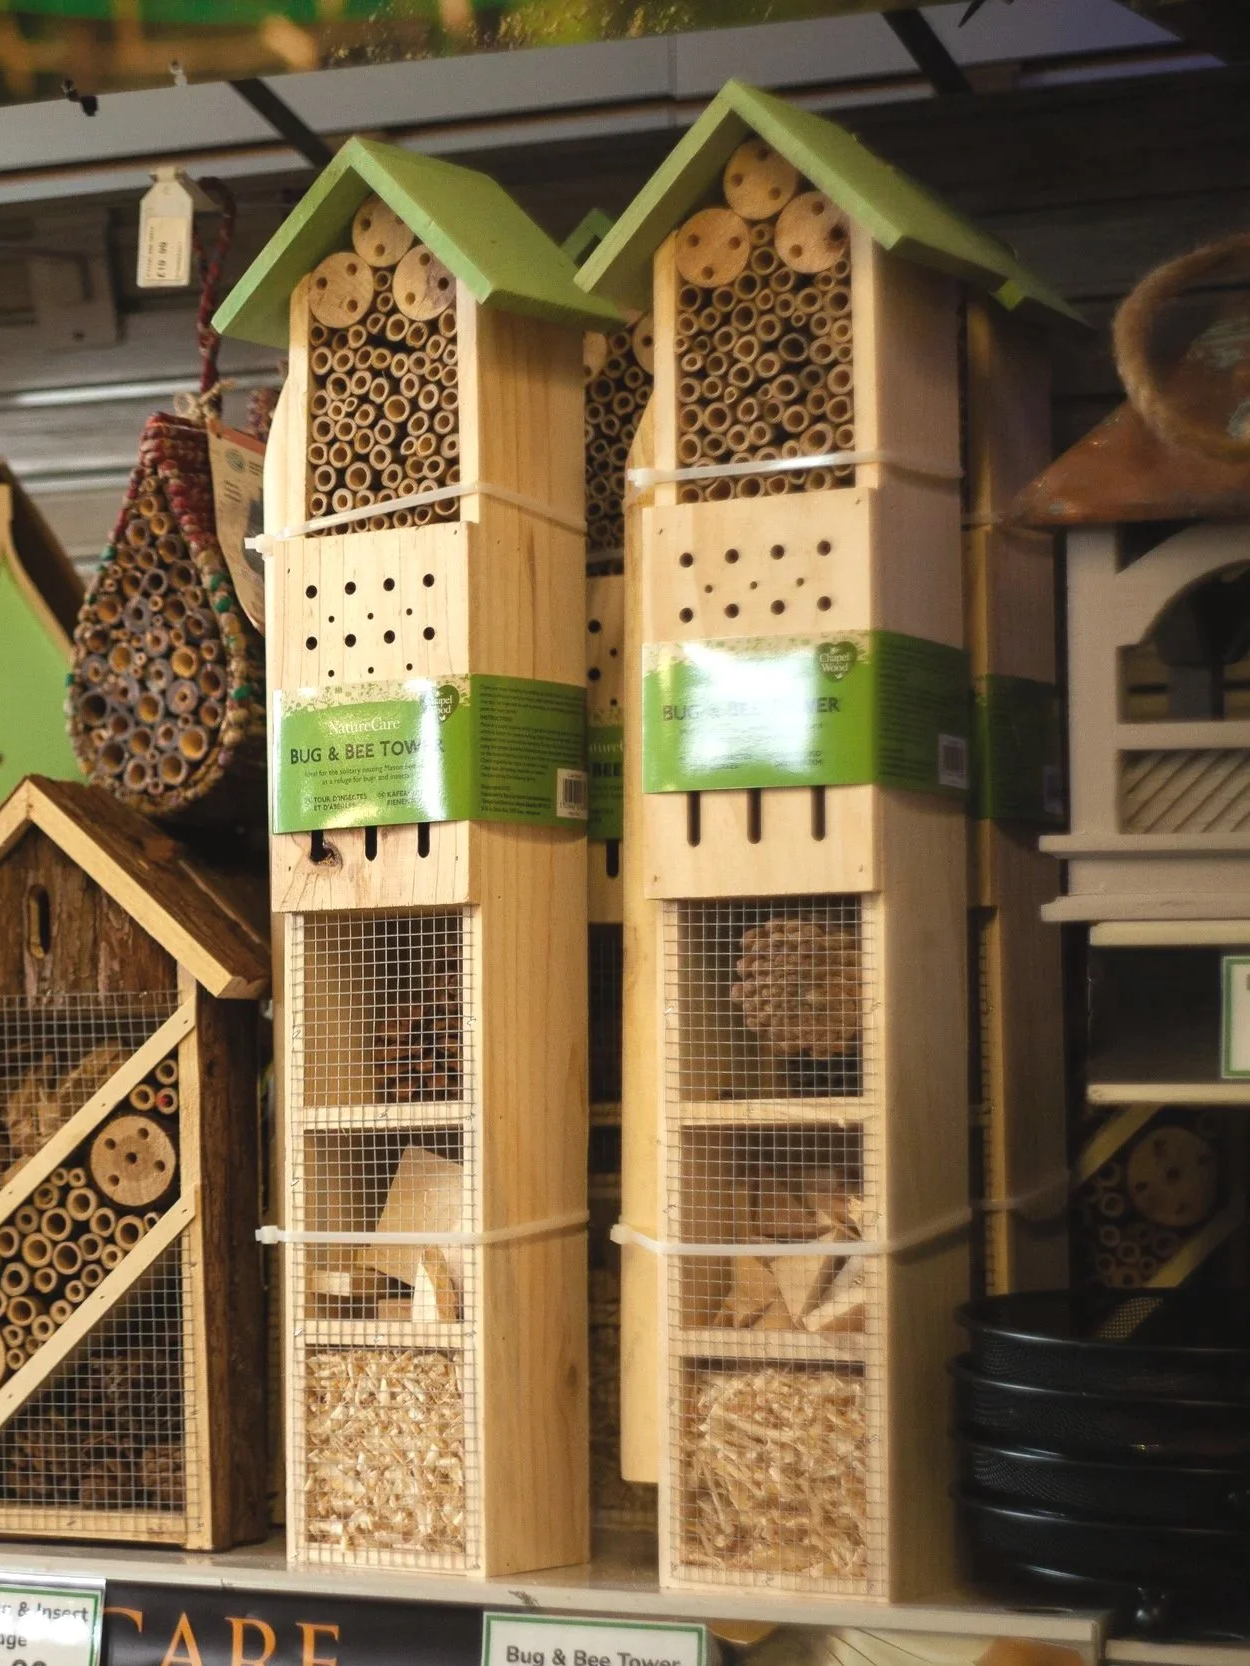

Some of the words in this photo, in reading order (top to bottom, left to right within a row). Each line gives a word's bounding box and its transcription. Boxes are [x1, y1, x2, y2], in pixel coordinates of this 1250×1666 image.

[820, 652, 850, 664] Chapel
[822, 662, 848, 672] Wood
[662, 704, 702, 721] BUG
[328, 717, 400, 736] NatureCare
[290, 748, 322, 765] BUG
[328, 746, 339, 762] &
[345, 743, 375, 760] BEE
[18, 1601, 30, 1618] &
[103, 1606, 340, 1666] ARE
[506, 1645, 544, 1666] Bug
[551, 1648, 566, 1666] &
[573, 1649, 611, 1666] Bee
[617, 1652, 681, 1666] Tower
